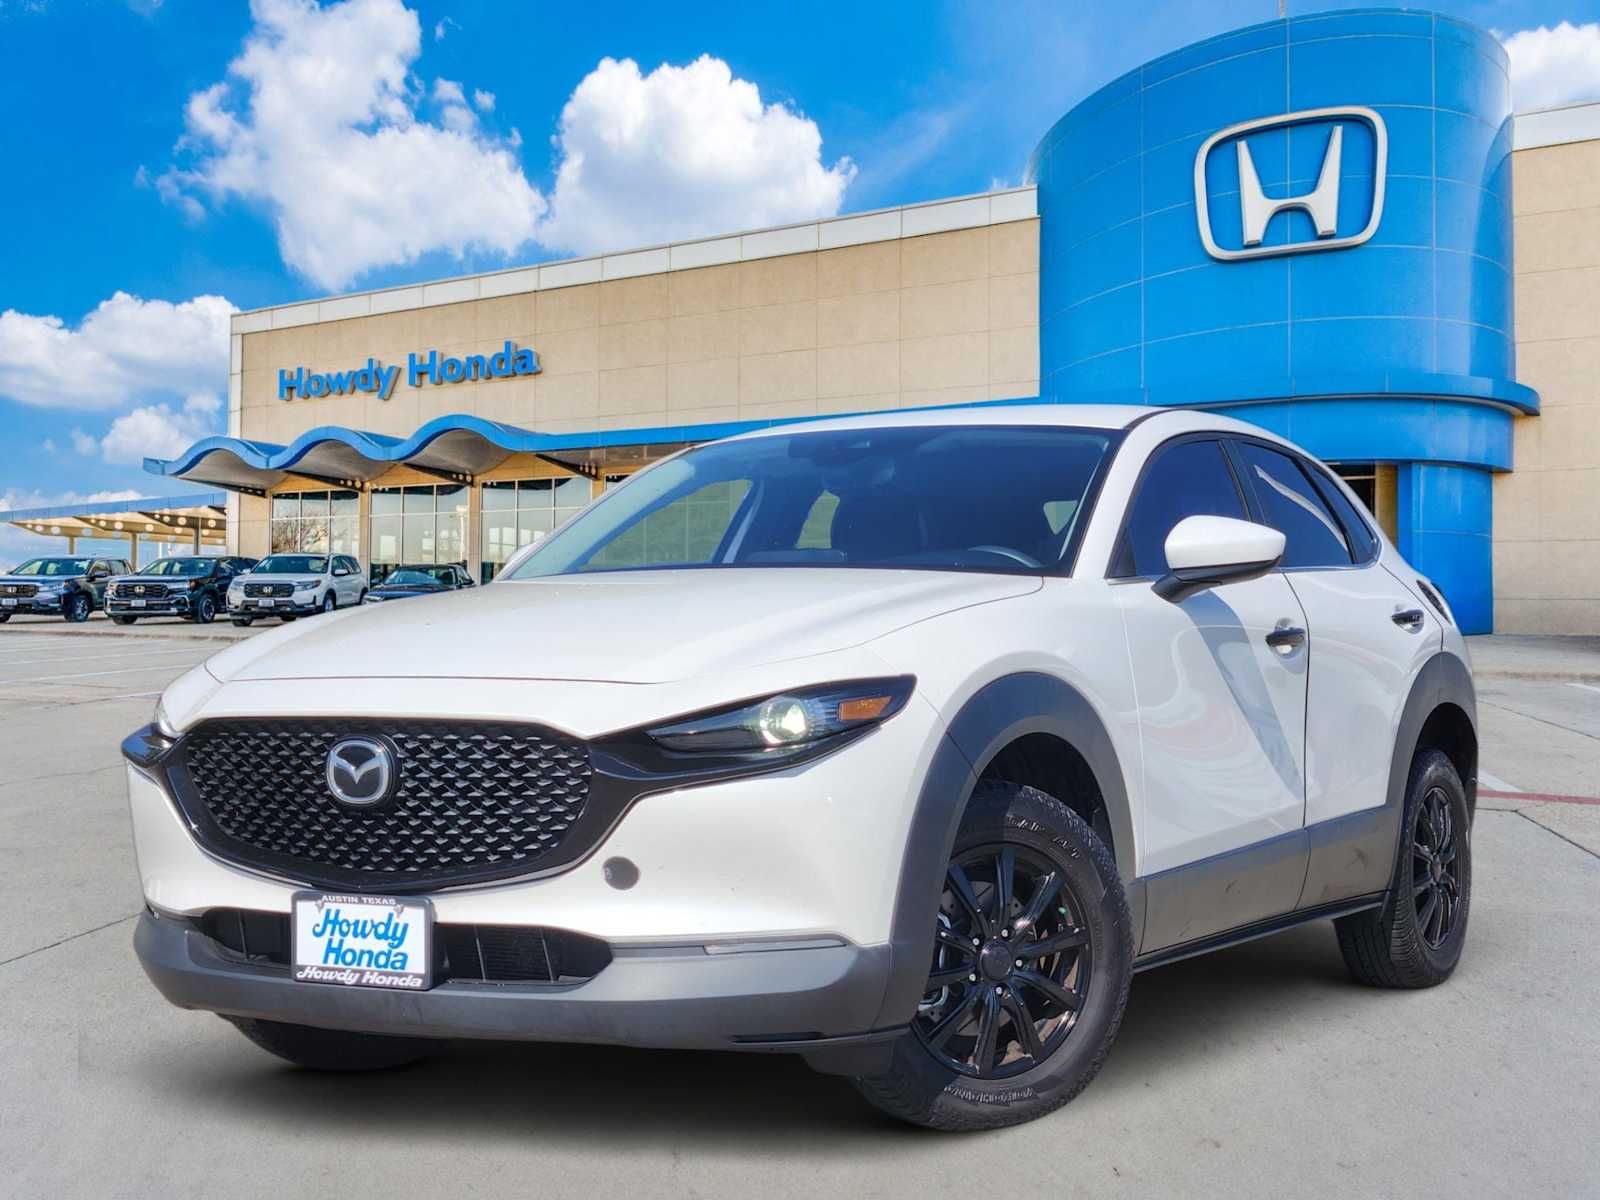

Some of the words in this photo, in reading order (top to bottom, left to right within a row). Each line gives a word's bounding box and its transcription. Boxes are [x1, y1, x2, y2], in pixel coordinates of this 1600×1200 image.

[278, 357, 400, 401] Howdy
[407, 341, 542, 387] Honda
[321, 895, 359, 903] AUSTIN
[362, 897, 396, 905] TEXAS
[312, 908, 409, 949] Howdy
[322, 938, 408, 970] Honda
[296, 966, 360, 984] Howdy
[361, 971, 423, 987] Honda
